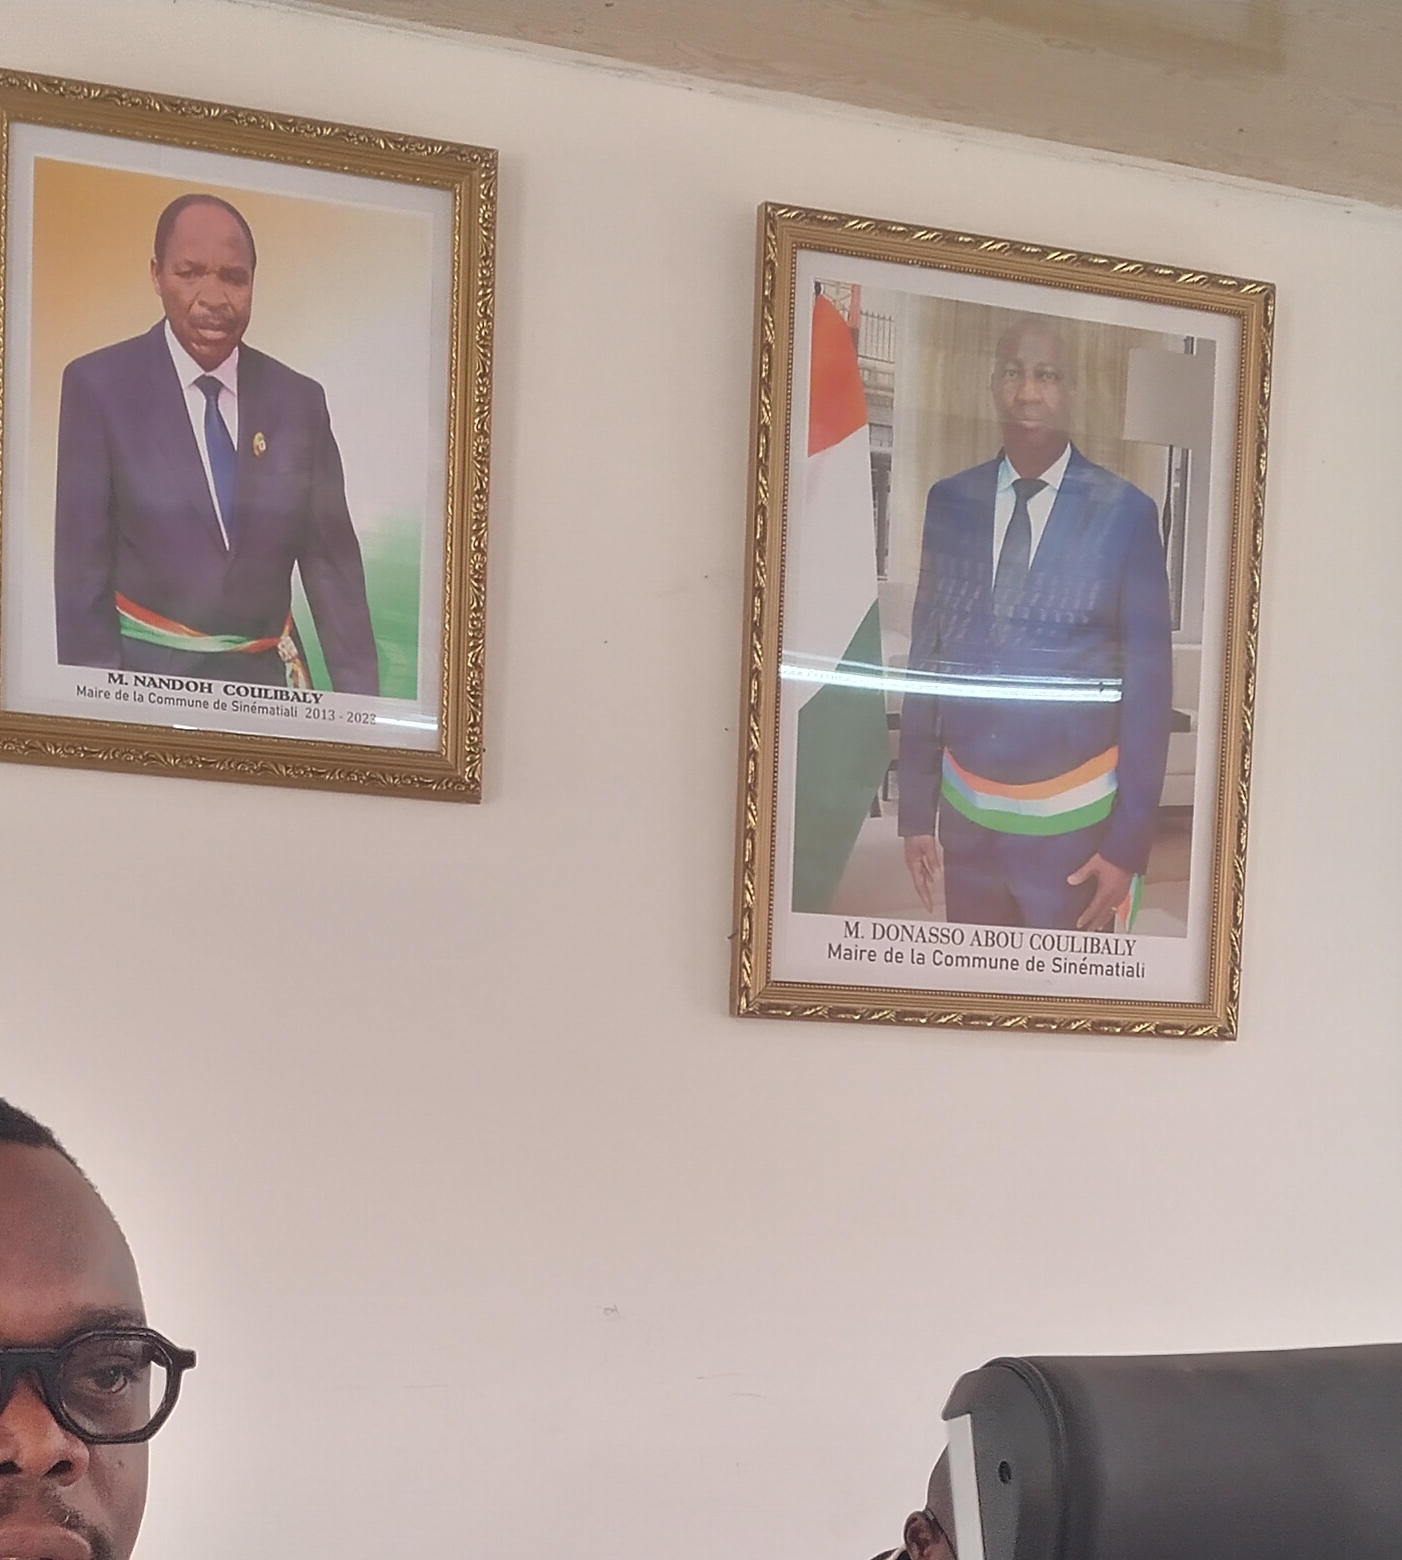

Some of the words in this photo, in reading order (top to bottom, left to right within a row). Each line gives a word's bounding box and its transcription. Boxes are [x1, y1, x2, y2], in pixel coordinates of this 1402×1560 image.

[76, 685, 111, 700] Maire
[115, 688, 129, 702] de
[132, 690, 145, 703] la
[148, 692, 209, 709] Commune
[213, 698, 228, 711] de
[231, 699, 297, 718] Sinématiali
[305, 707, 336, 721] 2013
[107, 671, 129, 687] M.
[133, 675, 213, 694] NANDOH
[223, 684, 323, 704] COULIBALY
[843, 920, 865, 940] M.
[872, 923, 965, 948] DONASSO
[970, 930, 1024, 950] ABOU
[1029, 934, 1137, 957] COULIBALY
[827, 944, 877, 963] Maire
[883, 947, 904, 965] de
[910, 948, 926, 966] la
[931, 950, 1020, 972] Commune
[1025, 956, 1046, 974] de
[1051, 956, 1146, 980] Sinématiali
